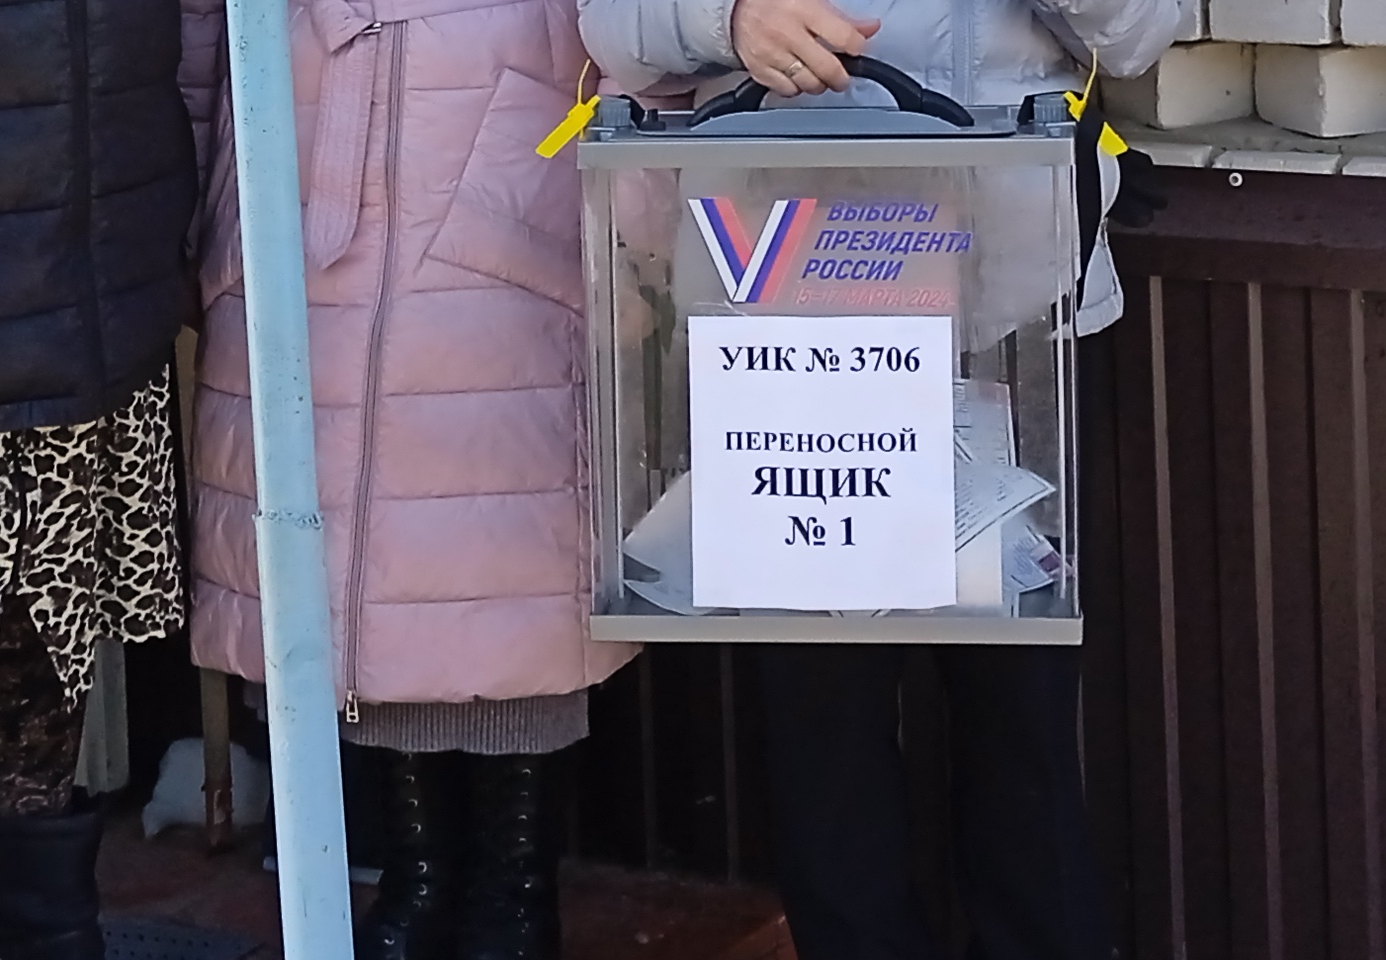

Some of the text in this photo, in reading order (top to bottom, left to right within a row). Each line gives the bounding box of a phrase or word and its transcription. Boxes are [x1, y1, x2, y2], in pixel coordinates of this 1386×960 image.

[826, 201, 939, 223] ВЫБОРЫ
[814, 229, 973, 255] ПРЕЗИДЕНТА
[801, 258, 904, 281] РОССИИ
[719, 346, 921, 373] УИК № 3706
[725, 427, 917, 454] ПЕРЕНОСНОЙ
[751, 466, 892, 506] ЯЩИК
[784, 515, 856, 547] № 1
